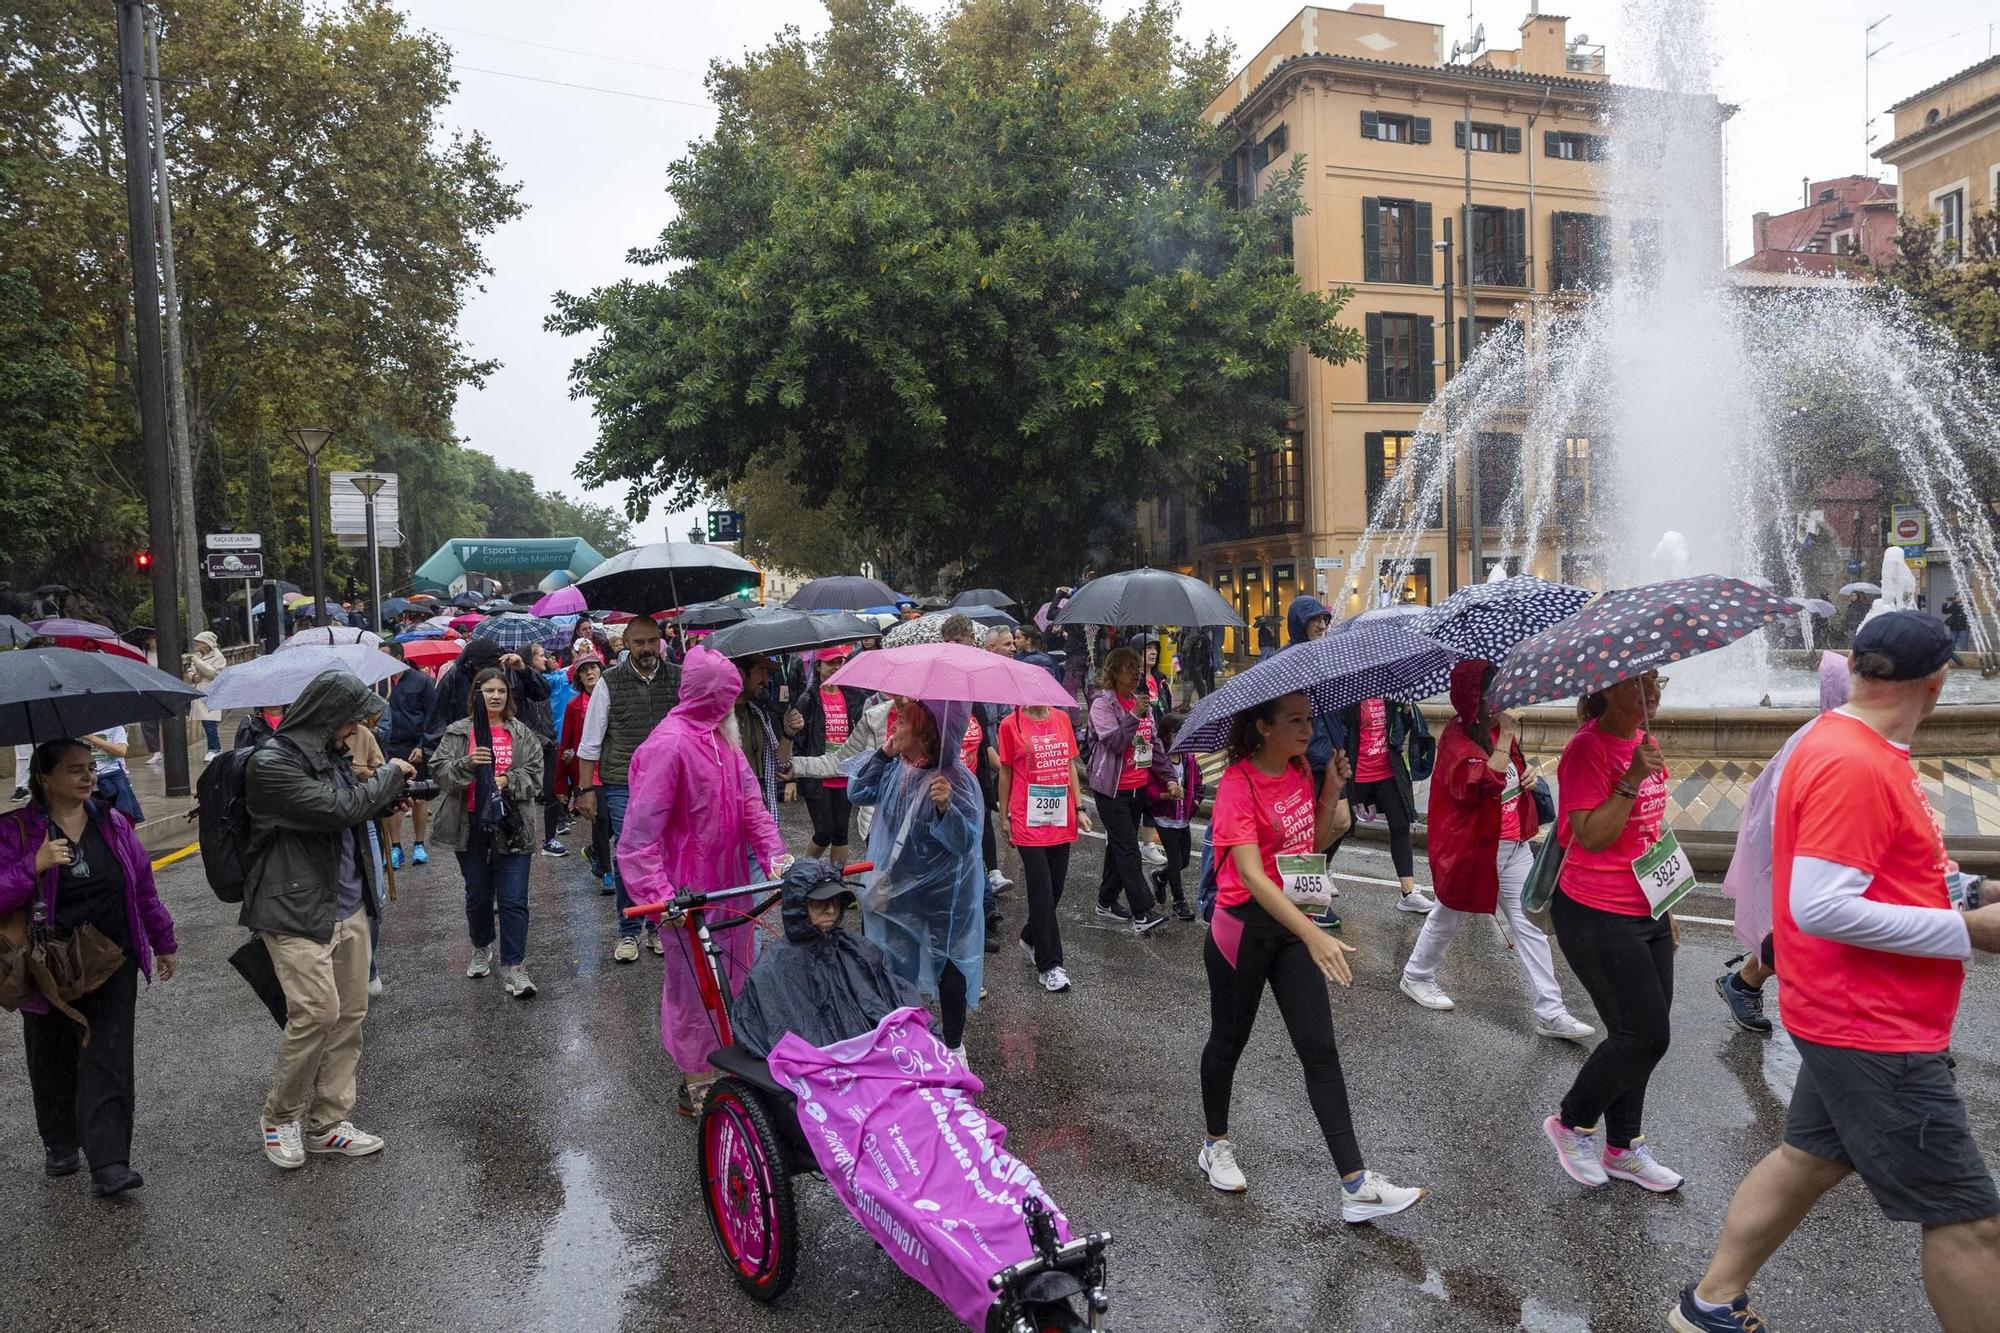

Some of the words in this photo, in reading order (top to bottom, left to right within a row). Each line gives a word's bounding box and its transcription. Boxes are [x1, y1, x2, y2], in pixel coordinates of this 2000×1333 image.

[718, 514, 732, 533] P
[482, 546, 518, 555] Esports
[483, 555, 513, 564] Consell
[519, 555, 530, 563] de
[531, 553, 569, 562] Mallorca
[1034, 743, 1044, 752] En
[1035, 749, 1062, 759] contra
[1036, 798, 1060, 810] 2300
[1640, 796, 1666, 813] cànc
[1281, 815, 1295, 828] En
[1285, 814, 1314, 838] contra
[1652, 855, 1681, 888] 3823
[1294, 876, 1323, 893] 4955
[873, 1147, 899, 1191] TELETRON
